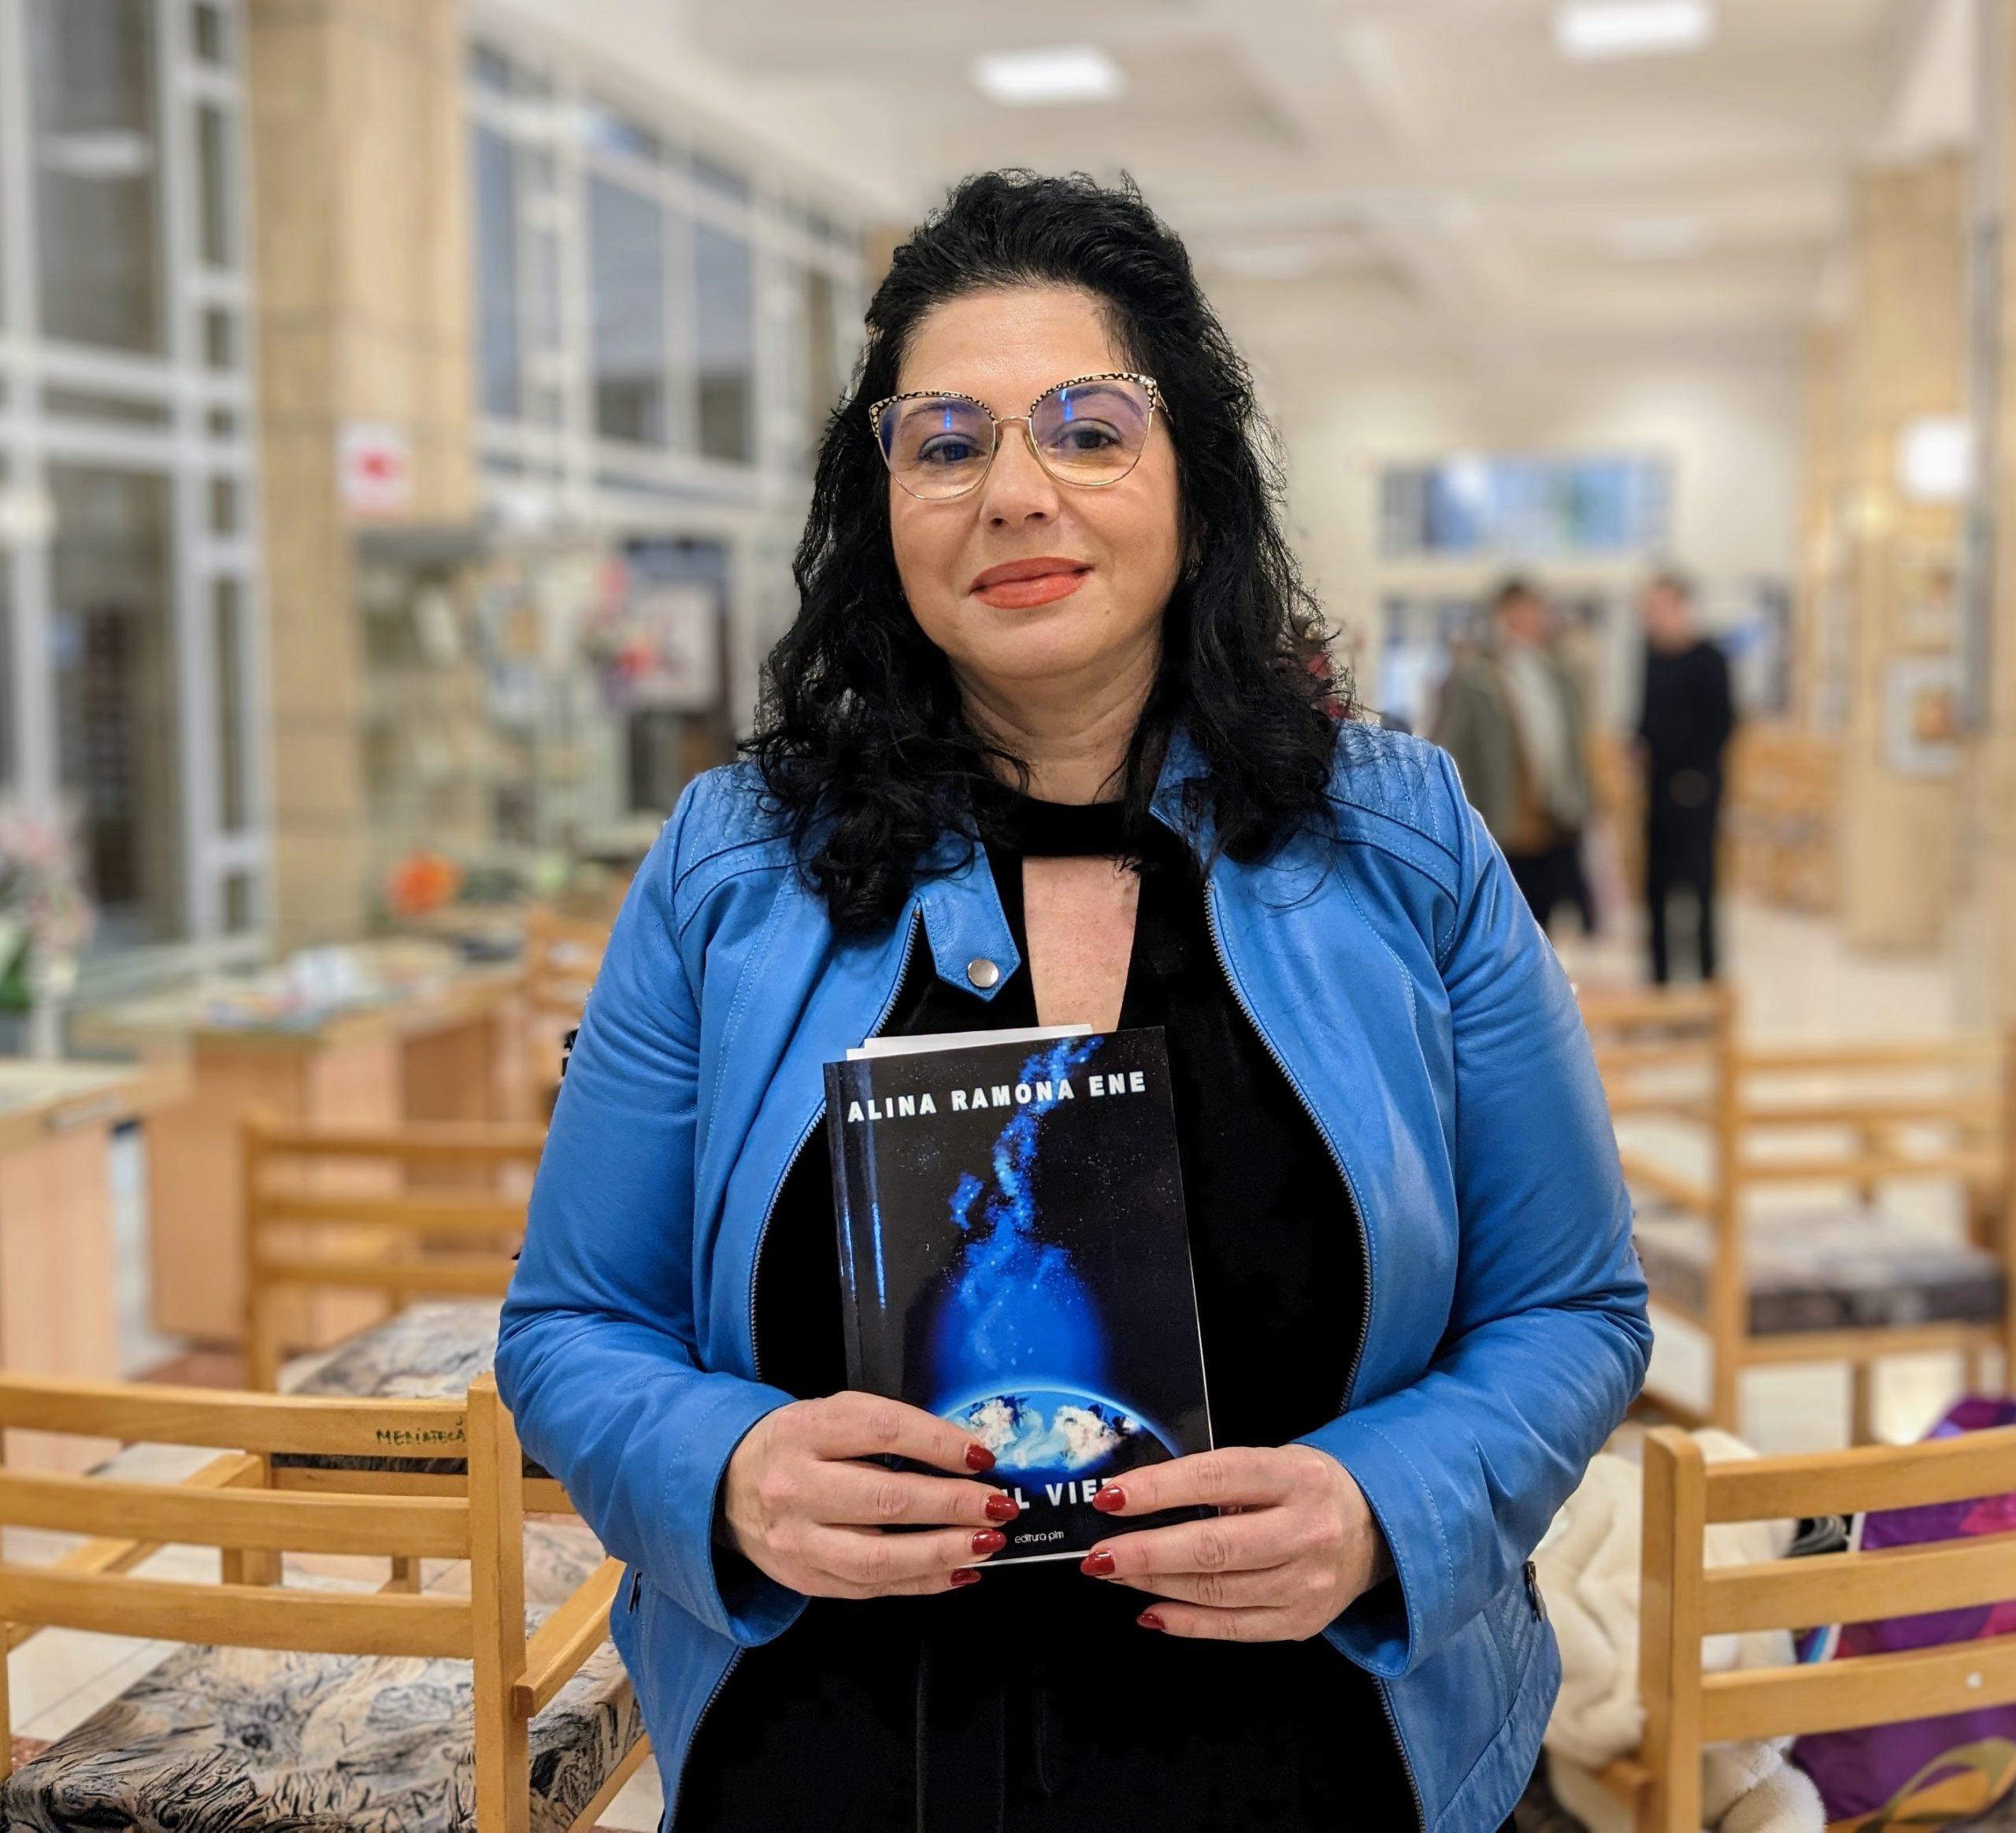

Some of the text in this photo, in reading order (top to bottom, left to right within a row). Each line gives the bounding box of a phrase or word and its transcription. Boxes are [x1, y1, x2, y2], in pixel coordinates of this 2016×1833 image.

[847, 1070, 1147, 1122] ALINA RAMONA ENE
[1002, 1487, 1030, 1510] L
[1014, 1533, 1047, 1544] editura
